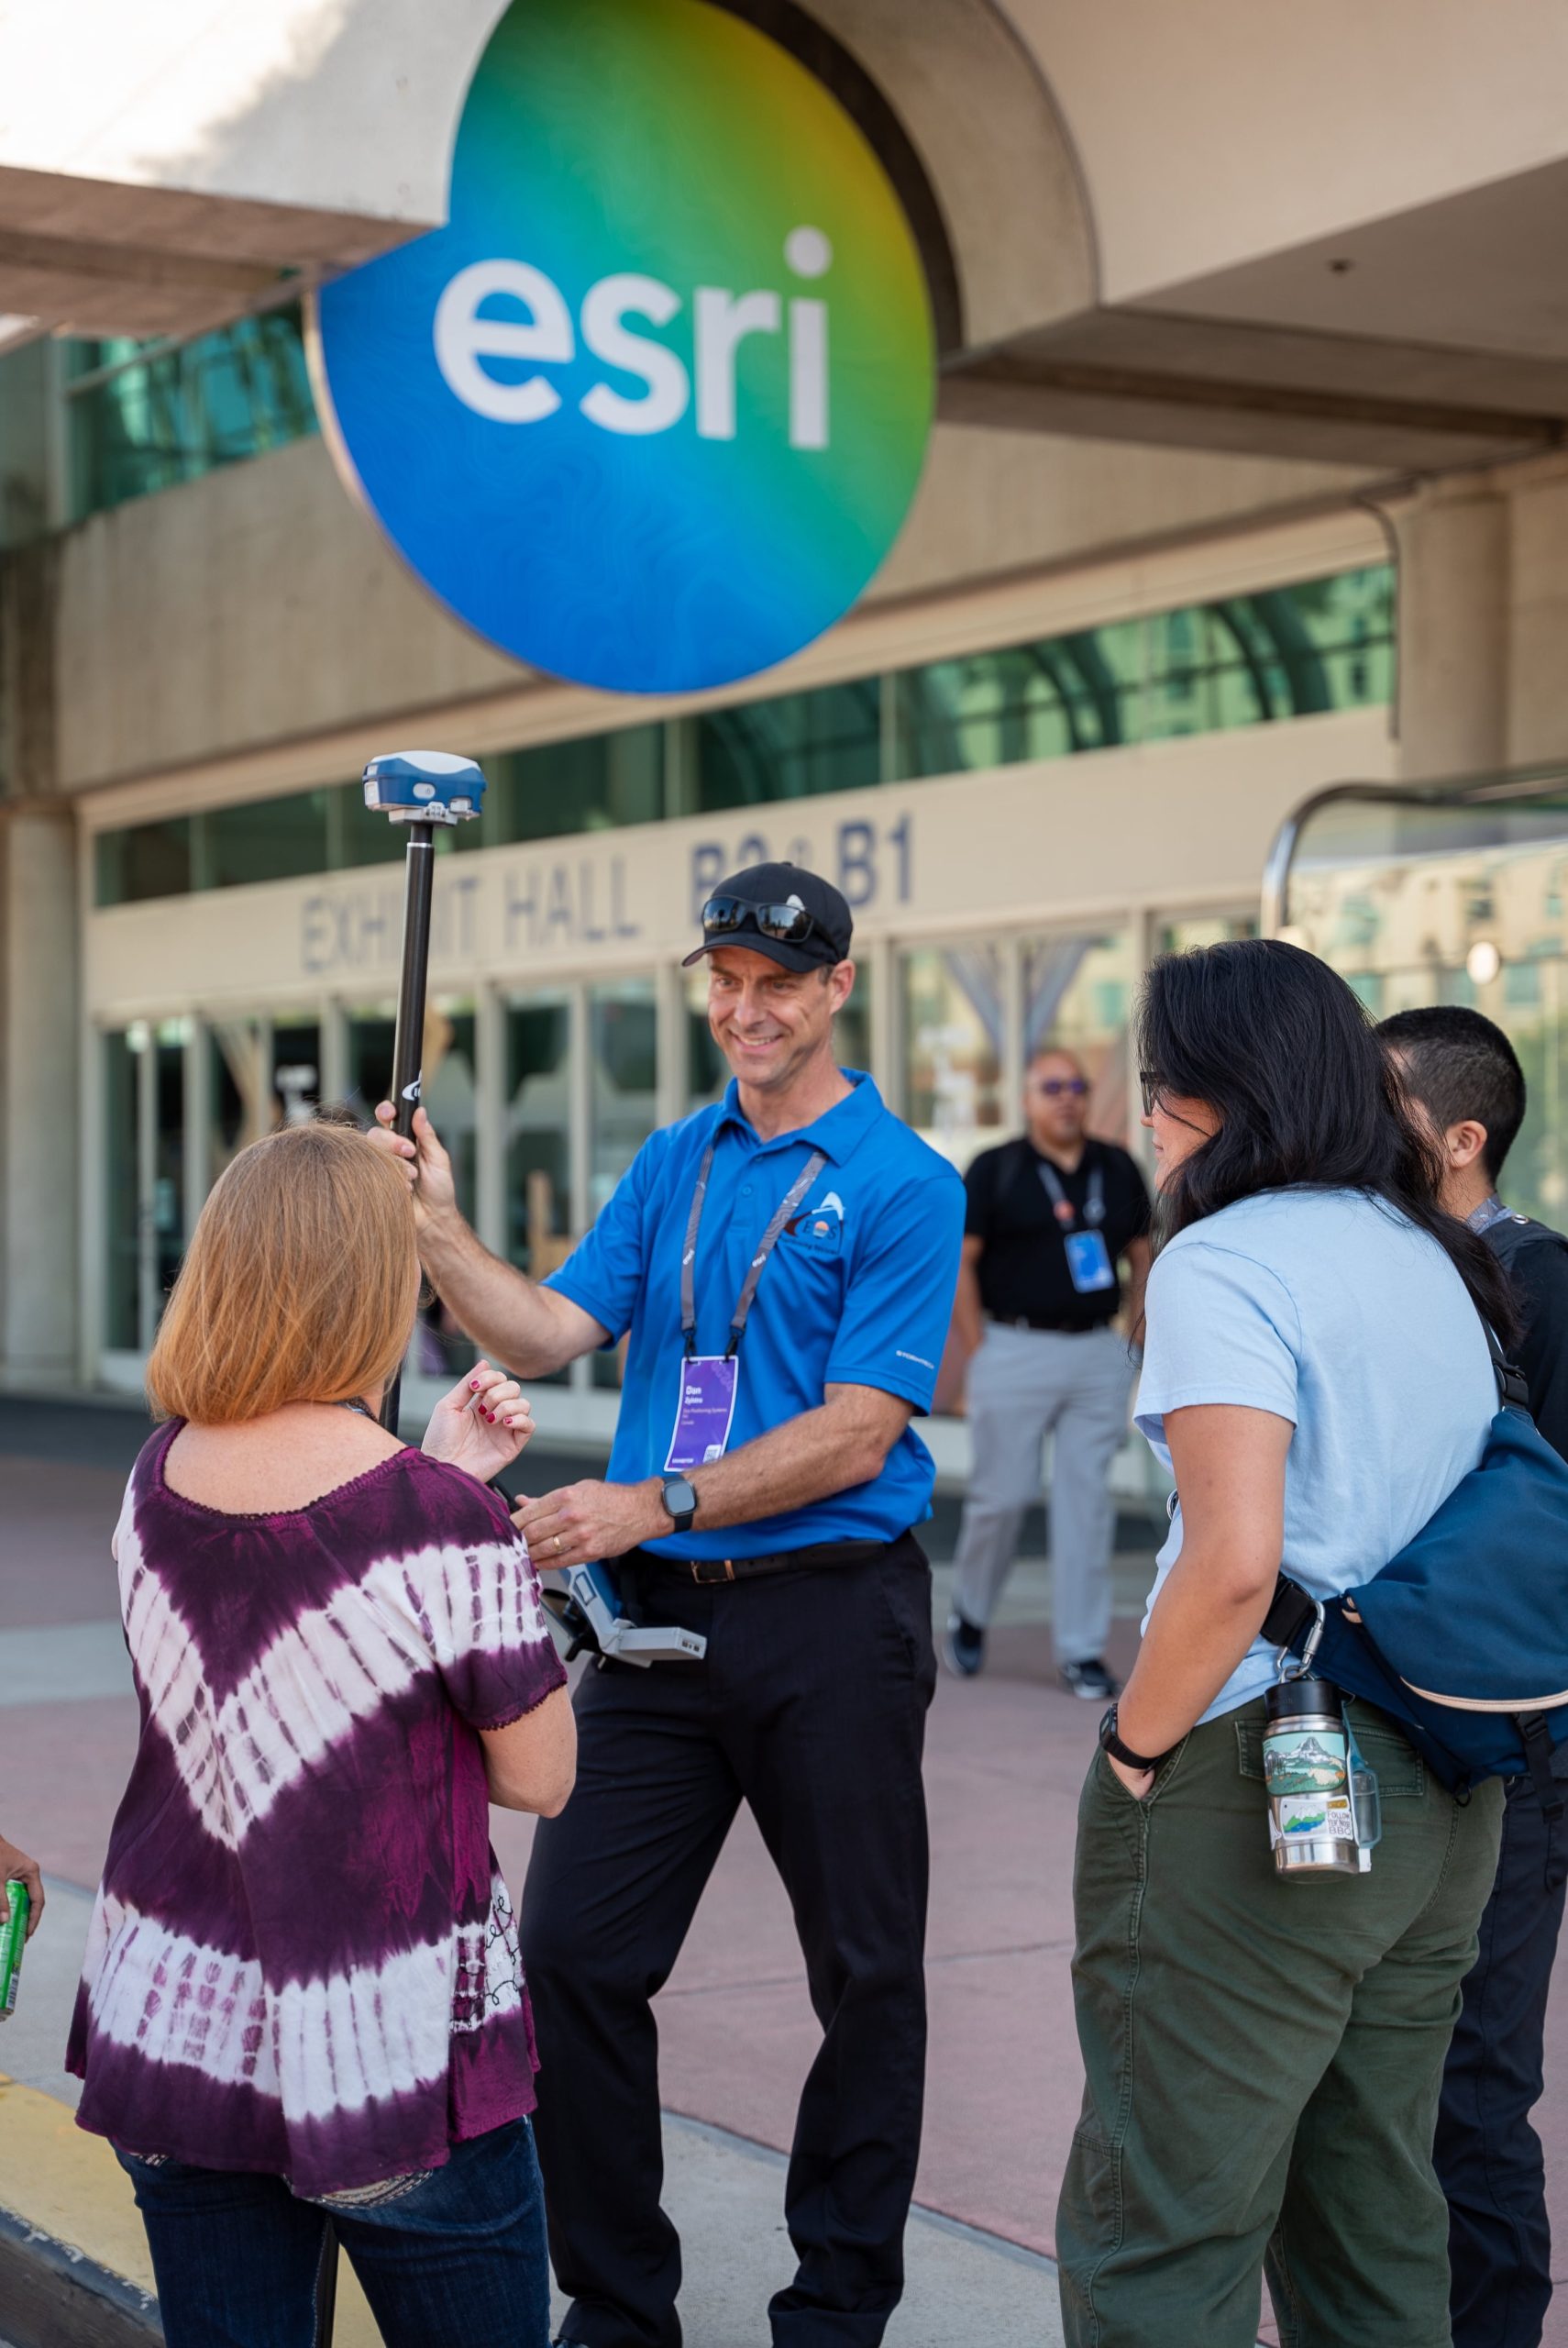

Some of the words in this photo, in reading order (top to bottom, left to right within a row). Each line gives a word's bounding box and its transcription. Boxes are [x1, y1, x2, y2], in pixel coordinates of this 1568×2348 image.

[433, 226, 834, 450] esri
[301, 876, 481, 974] EXHIIT
[503, 854, 641, 950] HALL
[838, 811, 912, 909] B1
